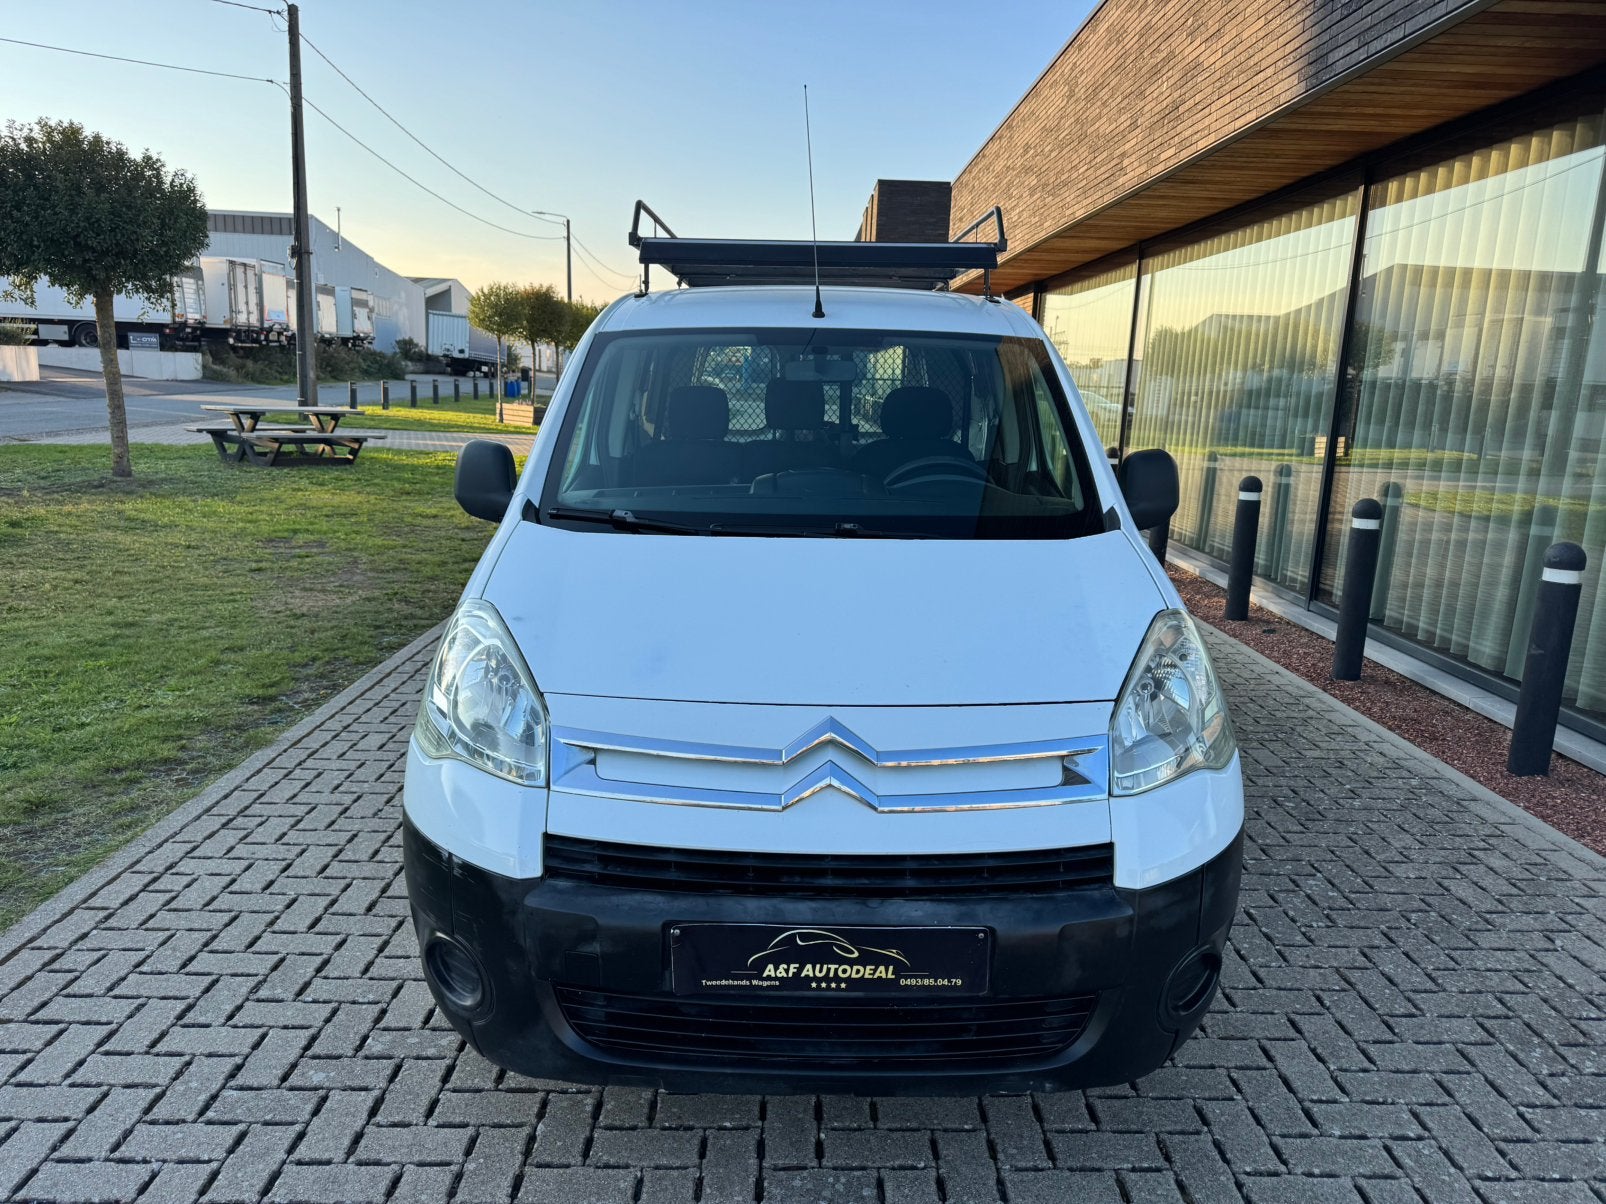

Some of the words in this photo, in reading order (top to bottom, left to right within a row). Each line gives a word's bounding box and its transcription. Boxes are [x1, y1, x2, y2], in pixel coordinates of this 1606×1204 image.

[762, 963, 800, 978] A&F
[800, 963, 896, 979] AUTODEAL
[751, 979, 780, 987] Wagens
[899, 978, 962, 986] 0493/85.04.79
